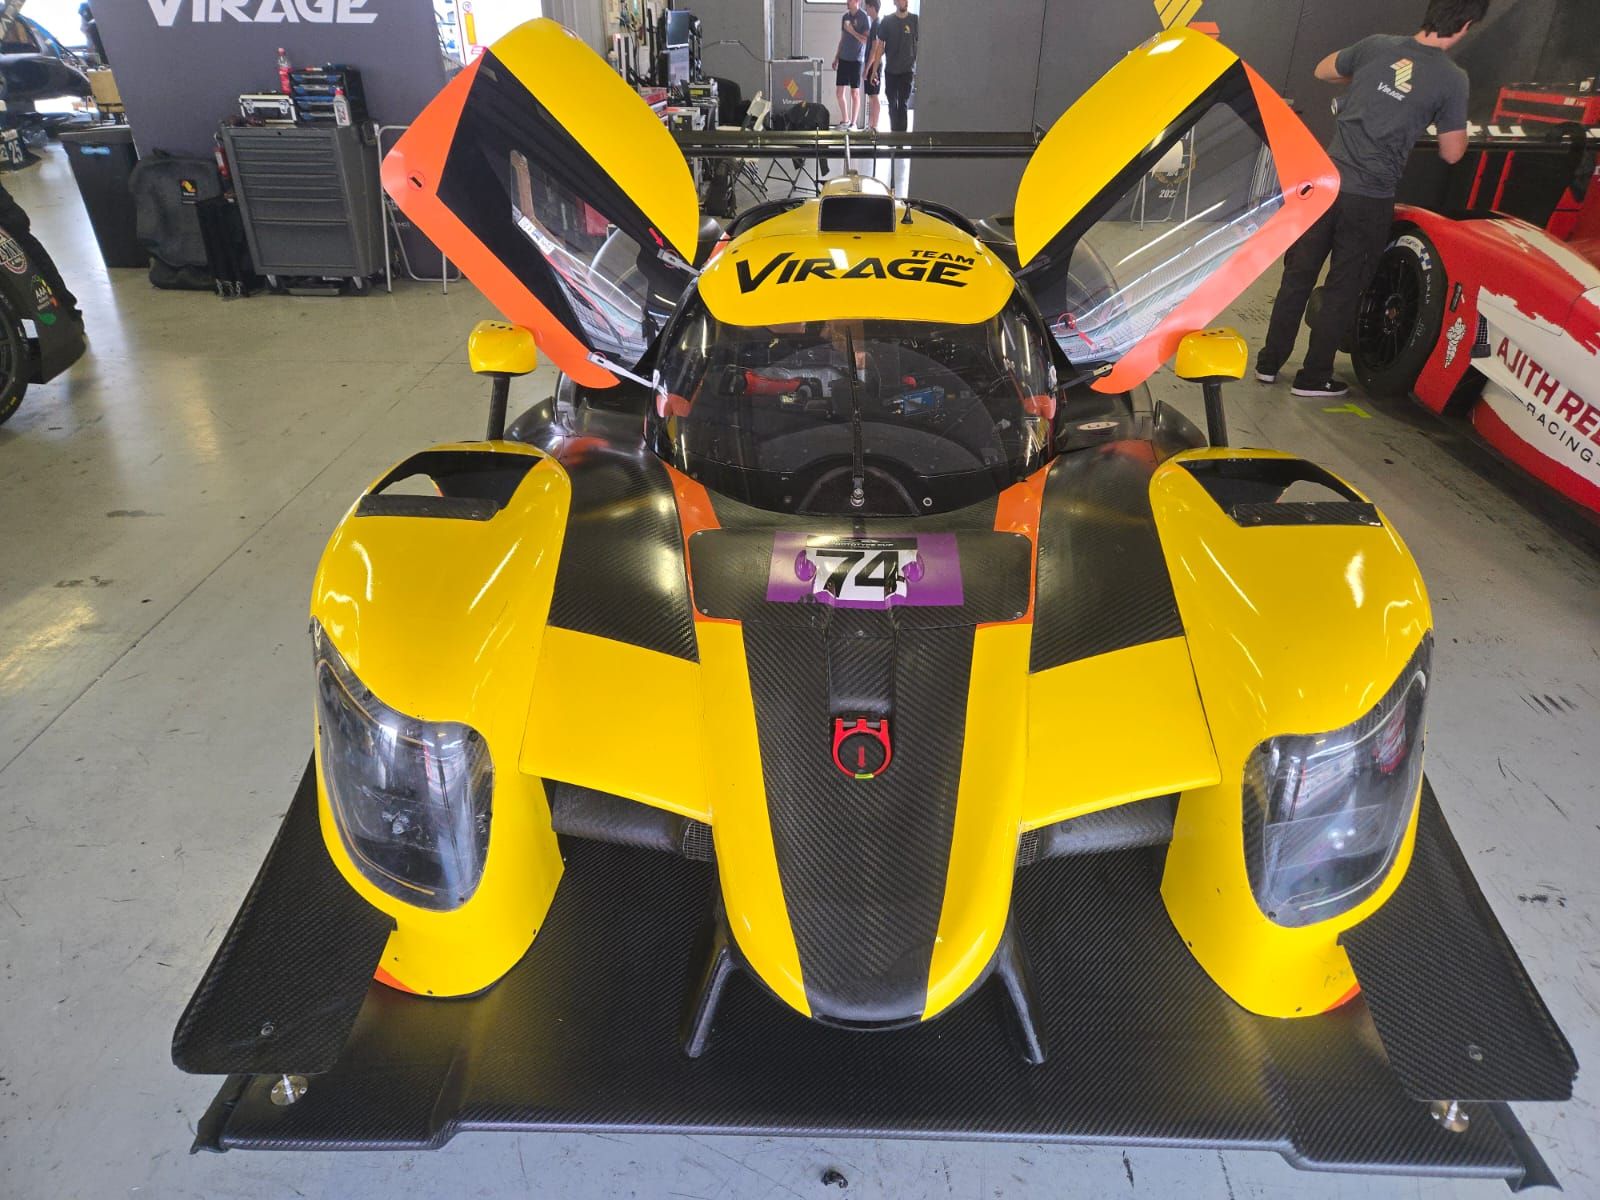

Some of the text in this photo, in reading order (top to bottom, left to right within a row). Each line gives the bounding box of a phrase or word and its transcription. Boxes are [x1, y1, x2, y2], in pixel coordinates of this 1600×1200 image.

[148, 0, 379, 27] VIRAGE
[735, 251, 973, 294] VIRAGE
[910, 249, 976, 265] TEAM
[1496, 336, 1560, 406] AJITH
[1526, 402, 1594, 464] RACING
[815, 549, 905, 600] 74
